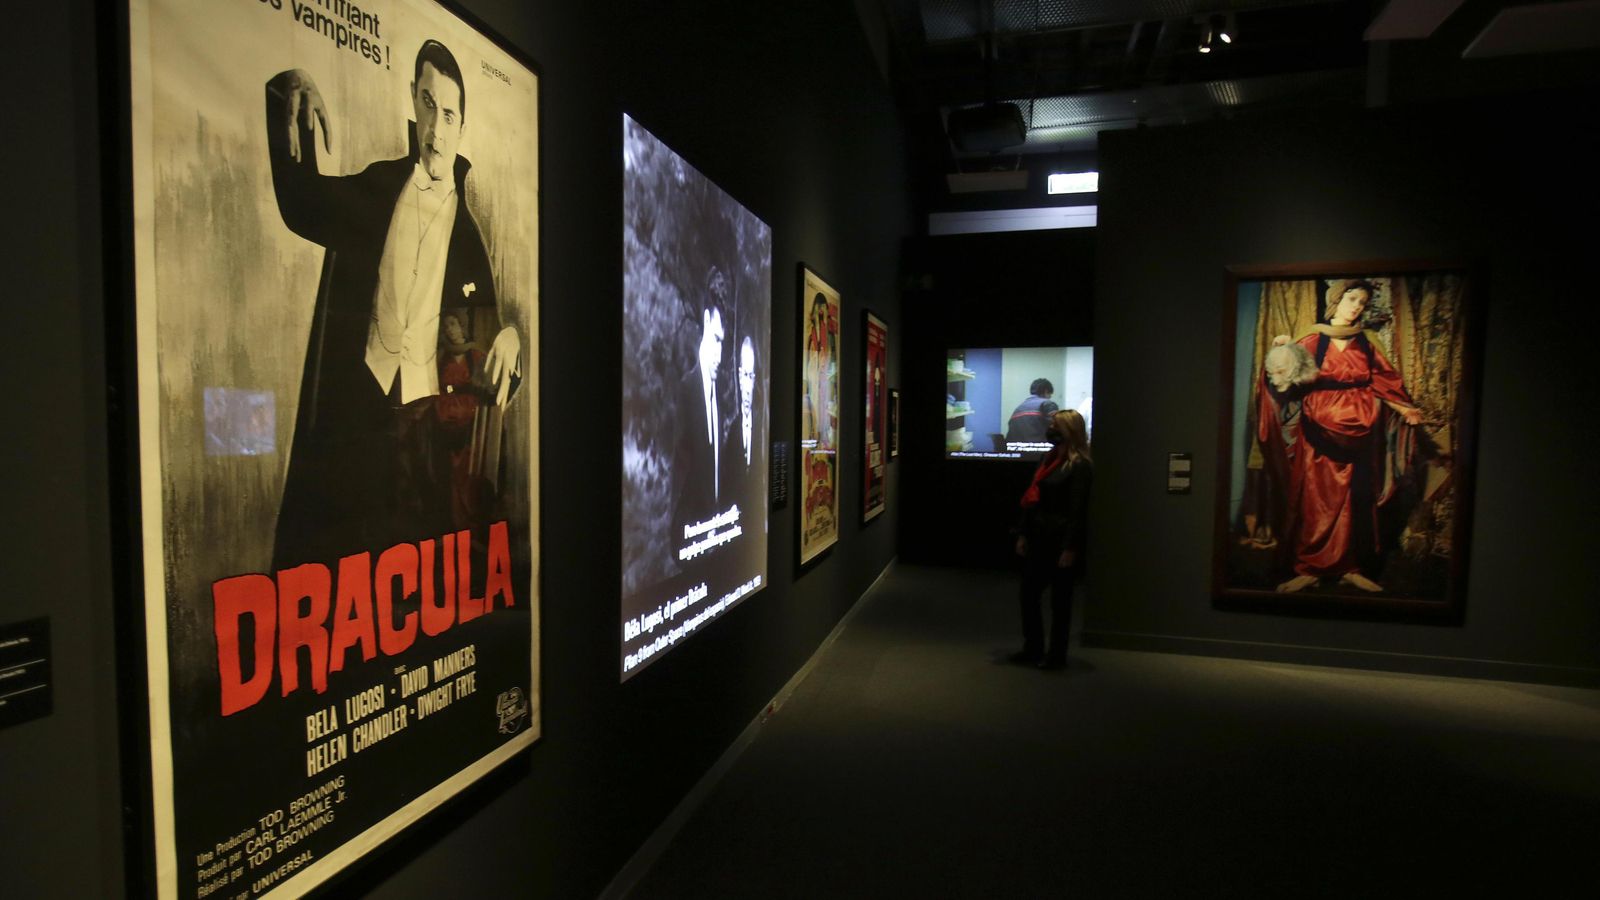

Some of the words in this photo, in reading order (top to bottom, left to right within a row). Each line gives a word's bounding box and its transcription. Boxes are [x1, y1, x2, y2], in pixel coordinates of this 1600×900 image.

[290, 0, 382, 65] vampires
[481, 60, 512, 86] UNIVERSAL
[212, 520, 515, 717] DRACULA
[306, 705, 339, 743] BELA
[345, 684, 385, 725] LUGOSI
[401, 665, 429, 699] DAVID
[433, 644, 476, 683] MANNERS
[306, 734, 348, 778] HELEN
[352, 705, 408, 754] CHANDLER
[417, 683, 453, 721] DWIGHT
[456, 671, 477, 701] FRYE
[197, 859, 228, 883] Produit
[229, 850, 242, 867] par
[246, 829, 277, 854] CARL
[280, 796, 332, 835] LAEMMLE
[216, 827, 256, 856] Production
[259, 809, 285, 830] TOD
[290, 775, 345, 815] BROWNING
[231, 866, 244, 883] par
[248, 847, 273, 869] TOD
[276, 810, 335, 853] BROWNING
[252, 850, 314, 893] UNIVERSAL
